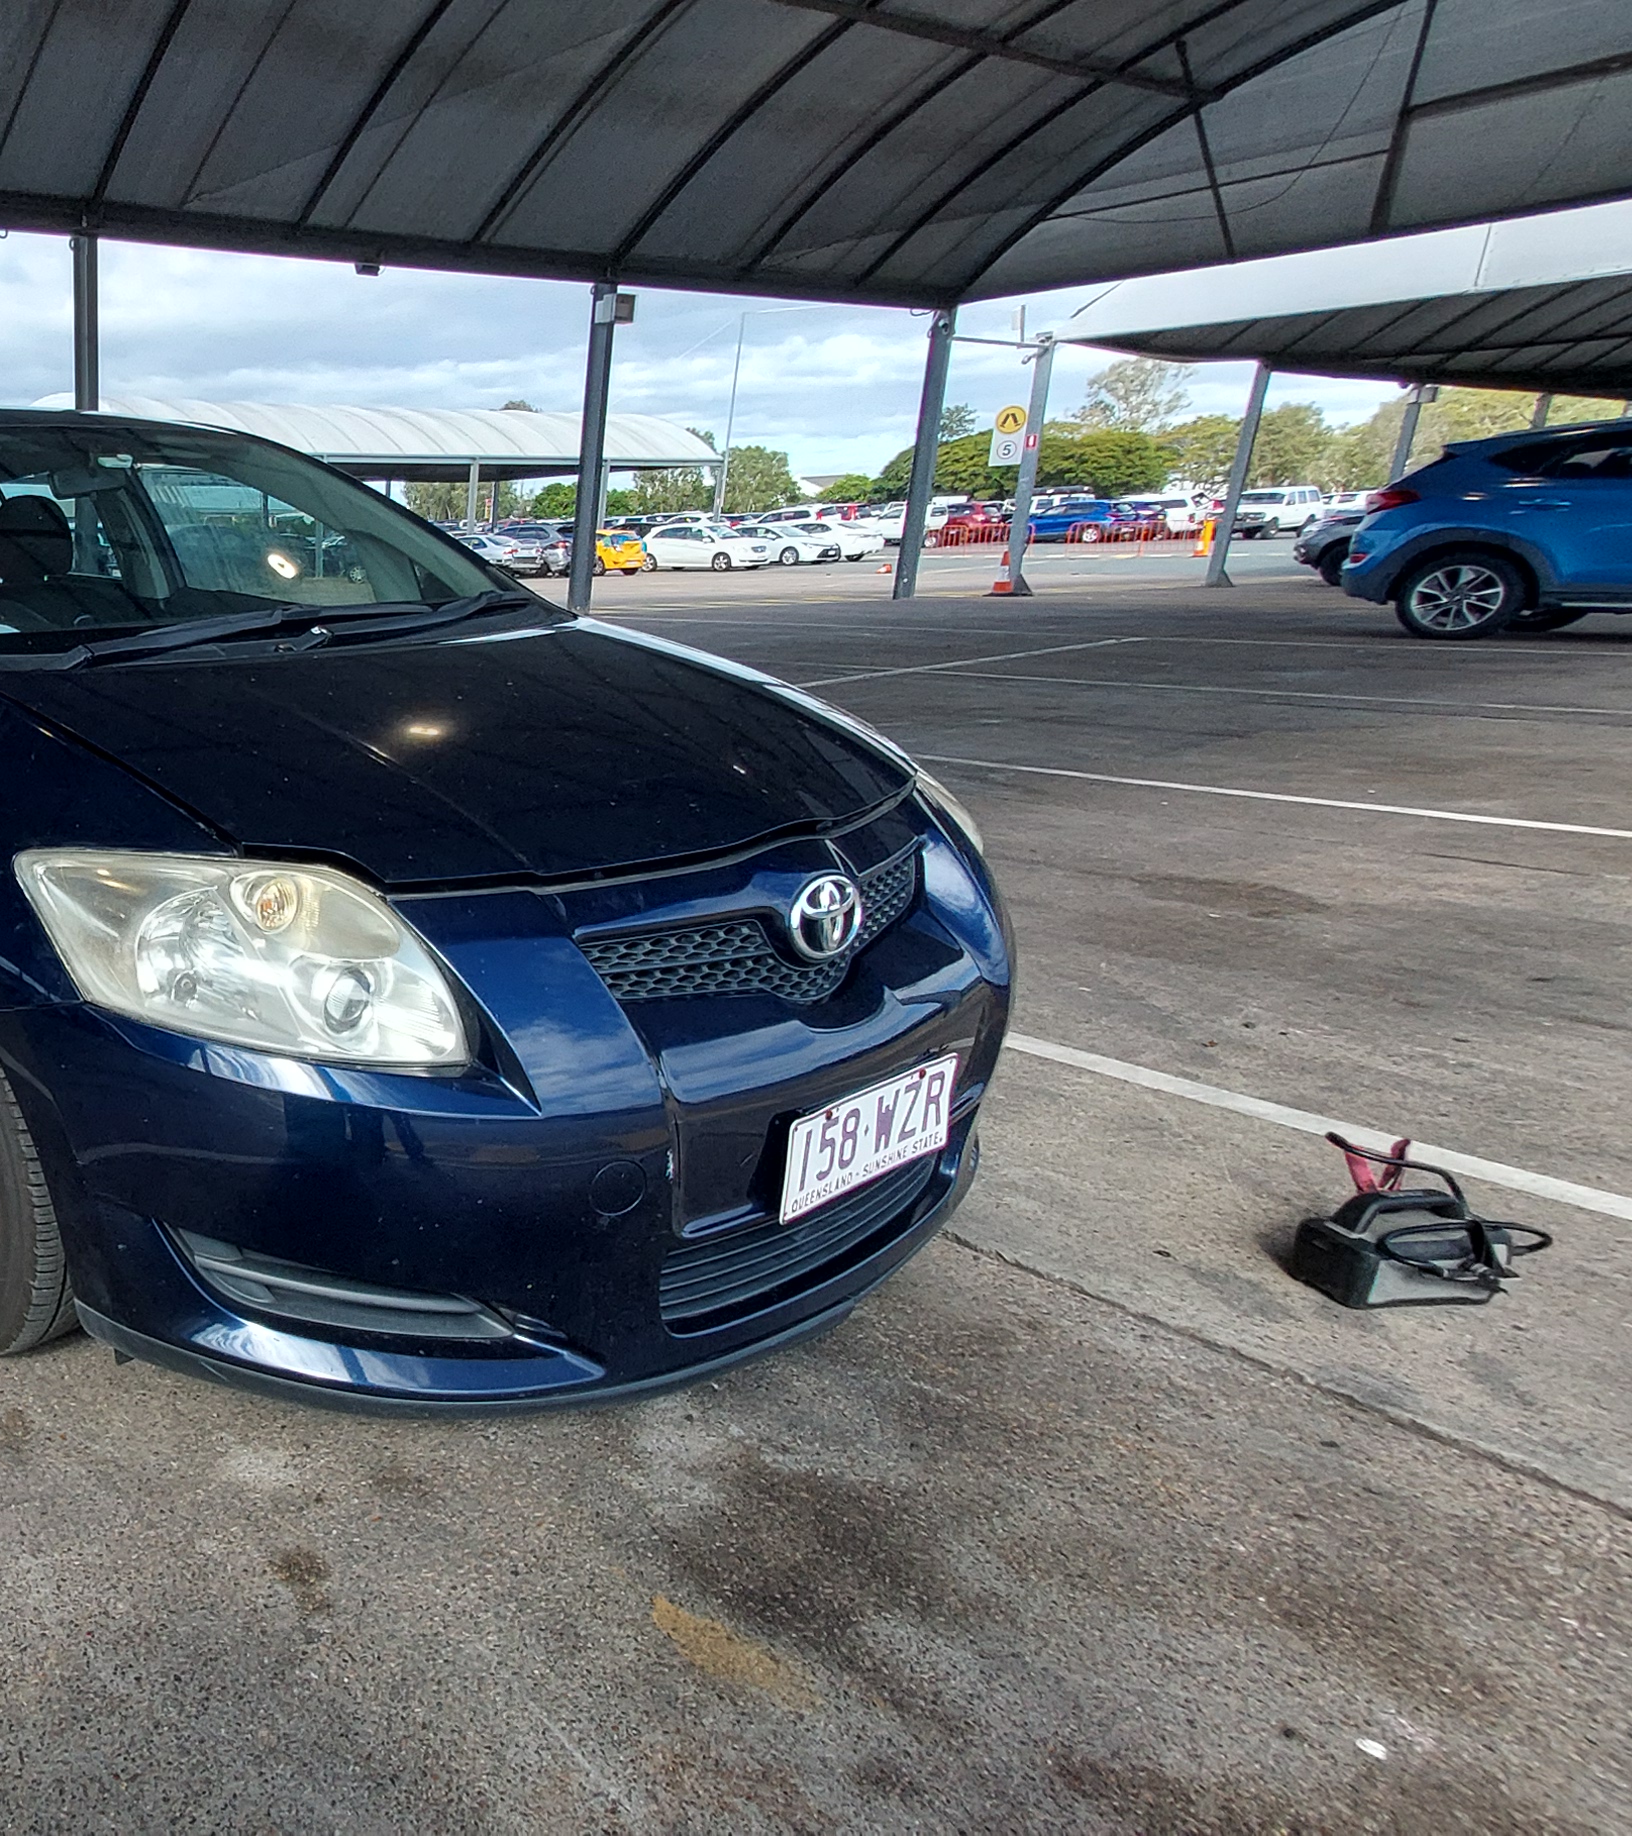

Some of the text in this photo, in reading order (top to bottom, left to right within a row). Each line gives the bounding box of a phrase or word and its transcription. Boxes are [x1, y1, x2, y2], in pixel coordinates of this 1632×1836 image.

[1002, 444, 1012, 456] 5
[798, 1070, 946, 1192] 158 WZR
[791, 1171, 854, 1213] QUEENSLAND
[861, 1147, 908, 1178] SUNSHINE
[912, 1132, 940, 1154] STATE
